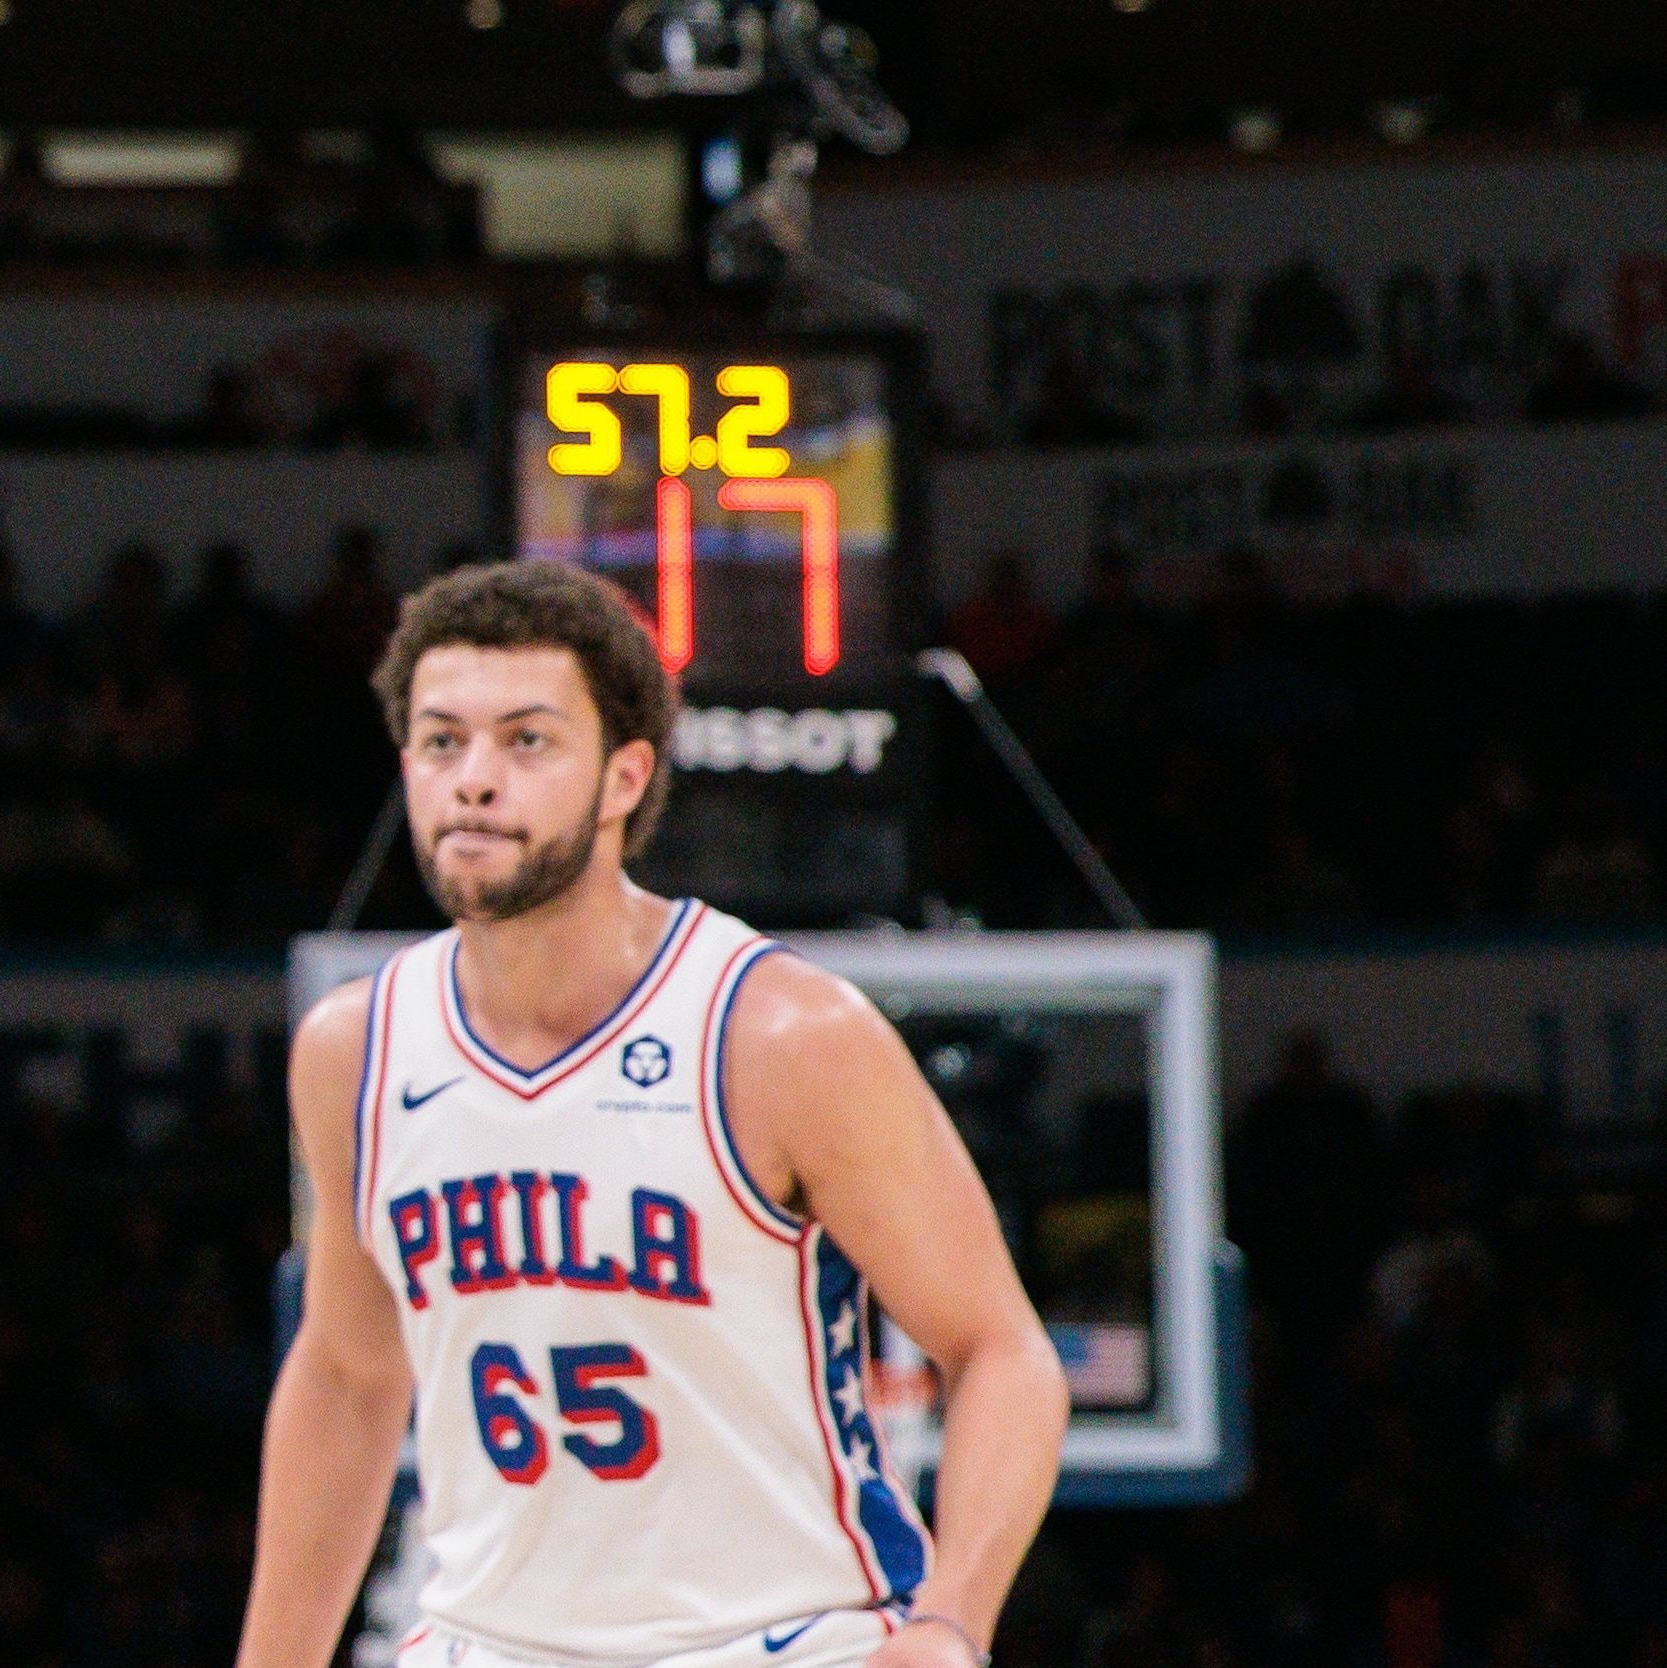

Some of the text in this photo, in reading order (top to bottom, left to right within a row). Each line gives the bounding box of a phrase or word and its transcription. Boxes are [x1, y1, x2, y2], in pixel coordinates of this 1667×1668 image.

[546, 362, 790, 478] 57.2
[657, 475, 840, 677] 17
[674, 707, 897, 774] ISSOT
[388, 1169, 712, 1312] PHILA
[469, 1340, 663, 1486] 65
